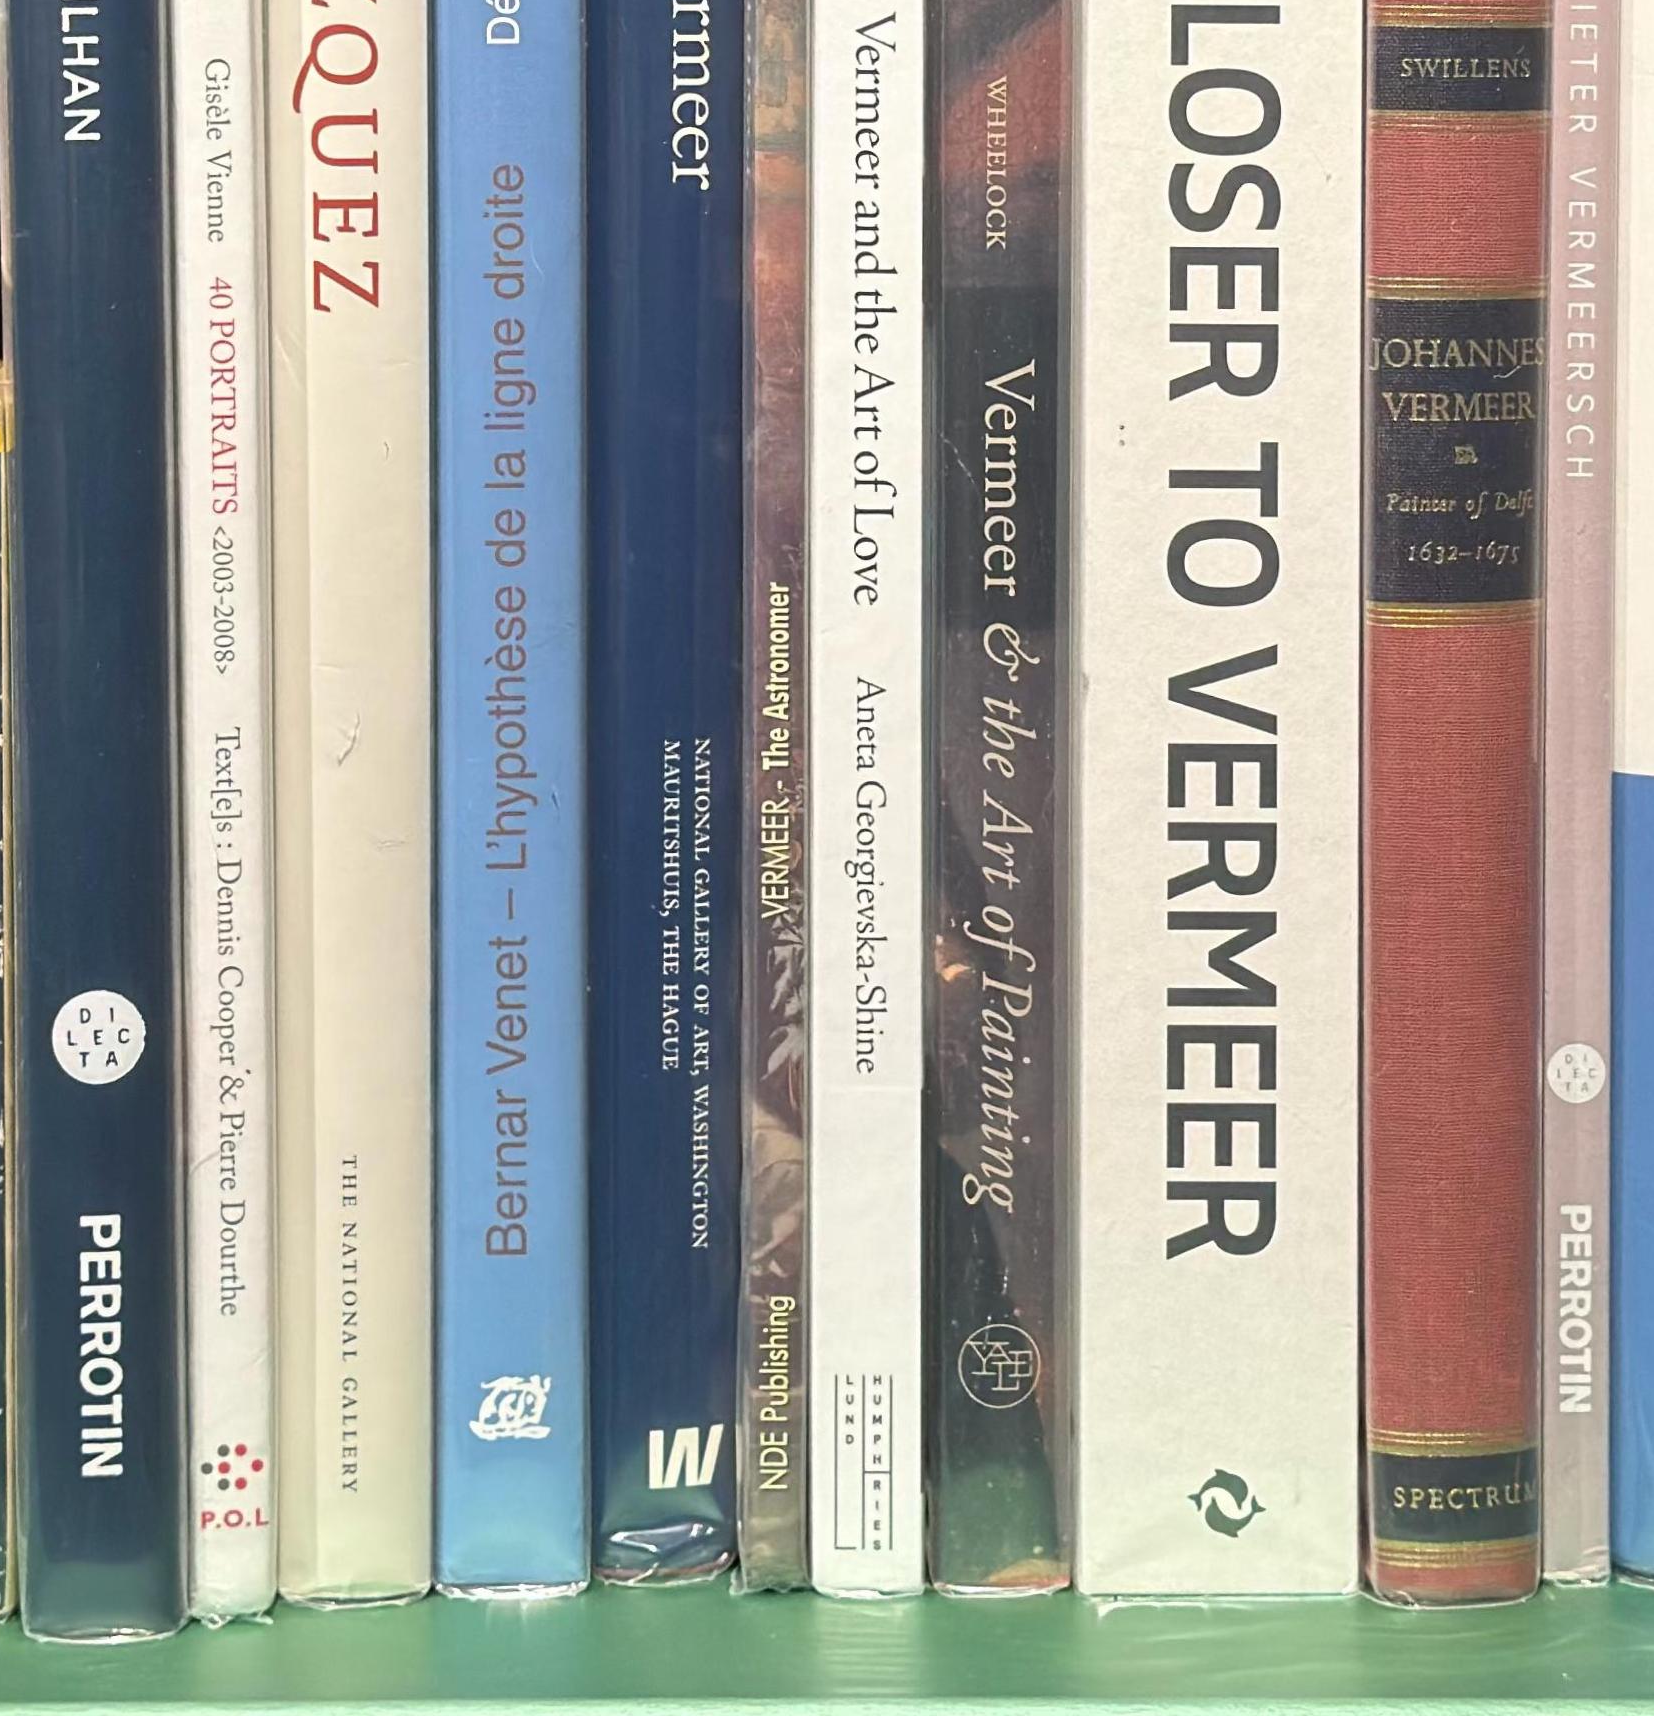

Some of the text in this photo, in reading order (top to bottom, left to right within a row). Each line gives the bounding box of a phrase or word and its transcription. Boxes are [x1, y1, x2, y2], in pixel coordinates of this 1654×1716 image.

[204, 58, 234, 244] Gisèle Vienne
[985, 76, 1008, 250] WHEELOCK
[1401, 56, 1531, 79] SWILLENS
[211, 277, 232, 309] 40
[483, 163, 526, 300] droite
[854, 12, 899, 608] Vermeer and the Art of Love
[1566, 166, 1597, 482] VERMEERSCH
[209, 318, 238, 514] PORTRAITS
[484, 317, 535, 432] ligne
[1368, 336, 1545, 370] JOHANNES
[1381, 392, 1535, 423] VERMEER
[485, 450, 526, 489] la
[485, 507, 526, 568] de
[1166, 441, 1281, 608] TO
[760, 582, 790, 918] VERMEER The Astronomer
[963, 359, 1041, 1213] Vermeer & the Art of Painting
[659, 740, 681, 1072] MAURITSHUIS, THE HAGUE
[844, 676, 889, 1076] Aneta Georgievska-Shine
[1165, 644, 1280, 1258] VERMEER
[210, 725, 246, 1318] Text[e]s Dennis Cooper & Pierre Dourthe
[486, 934, 527, 1075] Venet
[690, 739, 711, 1250] NATIONAL GALLERY OF ART, WASHINGTON
[486, 1090, 527, 1257] Bernar
[79, 1213, 124, 1477] PERROTIN
[341, 1155, 358, 1494] THE NATIONAL GALLERY
[761, 1295, 796, 1490] NDE Publishing
[1559, 1204, 1592, 1415] PERROTIN
